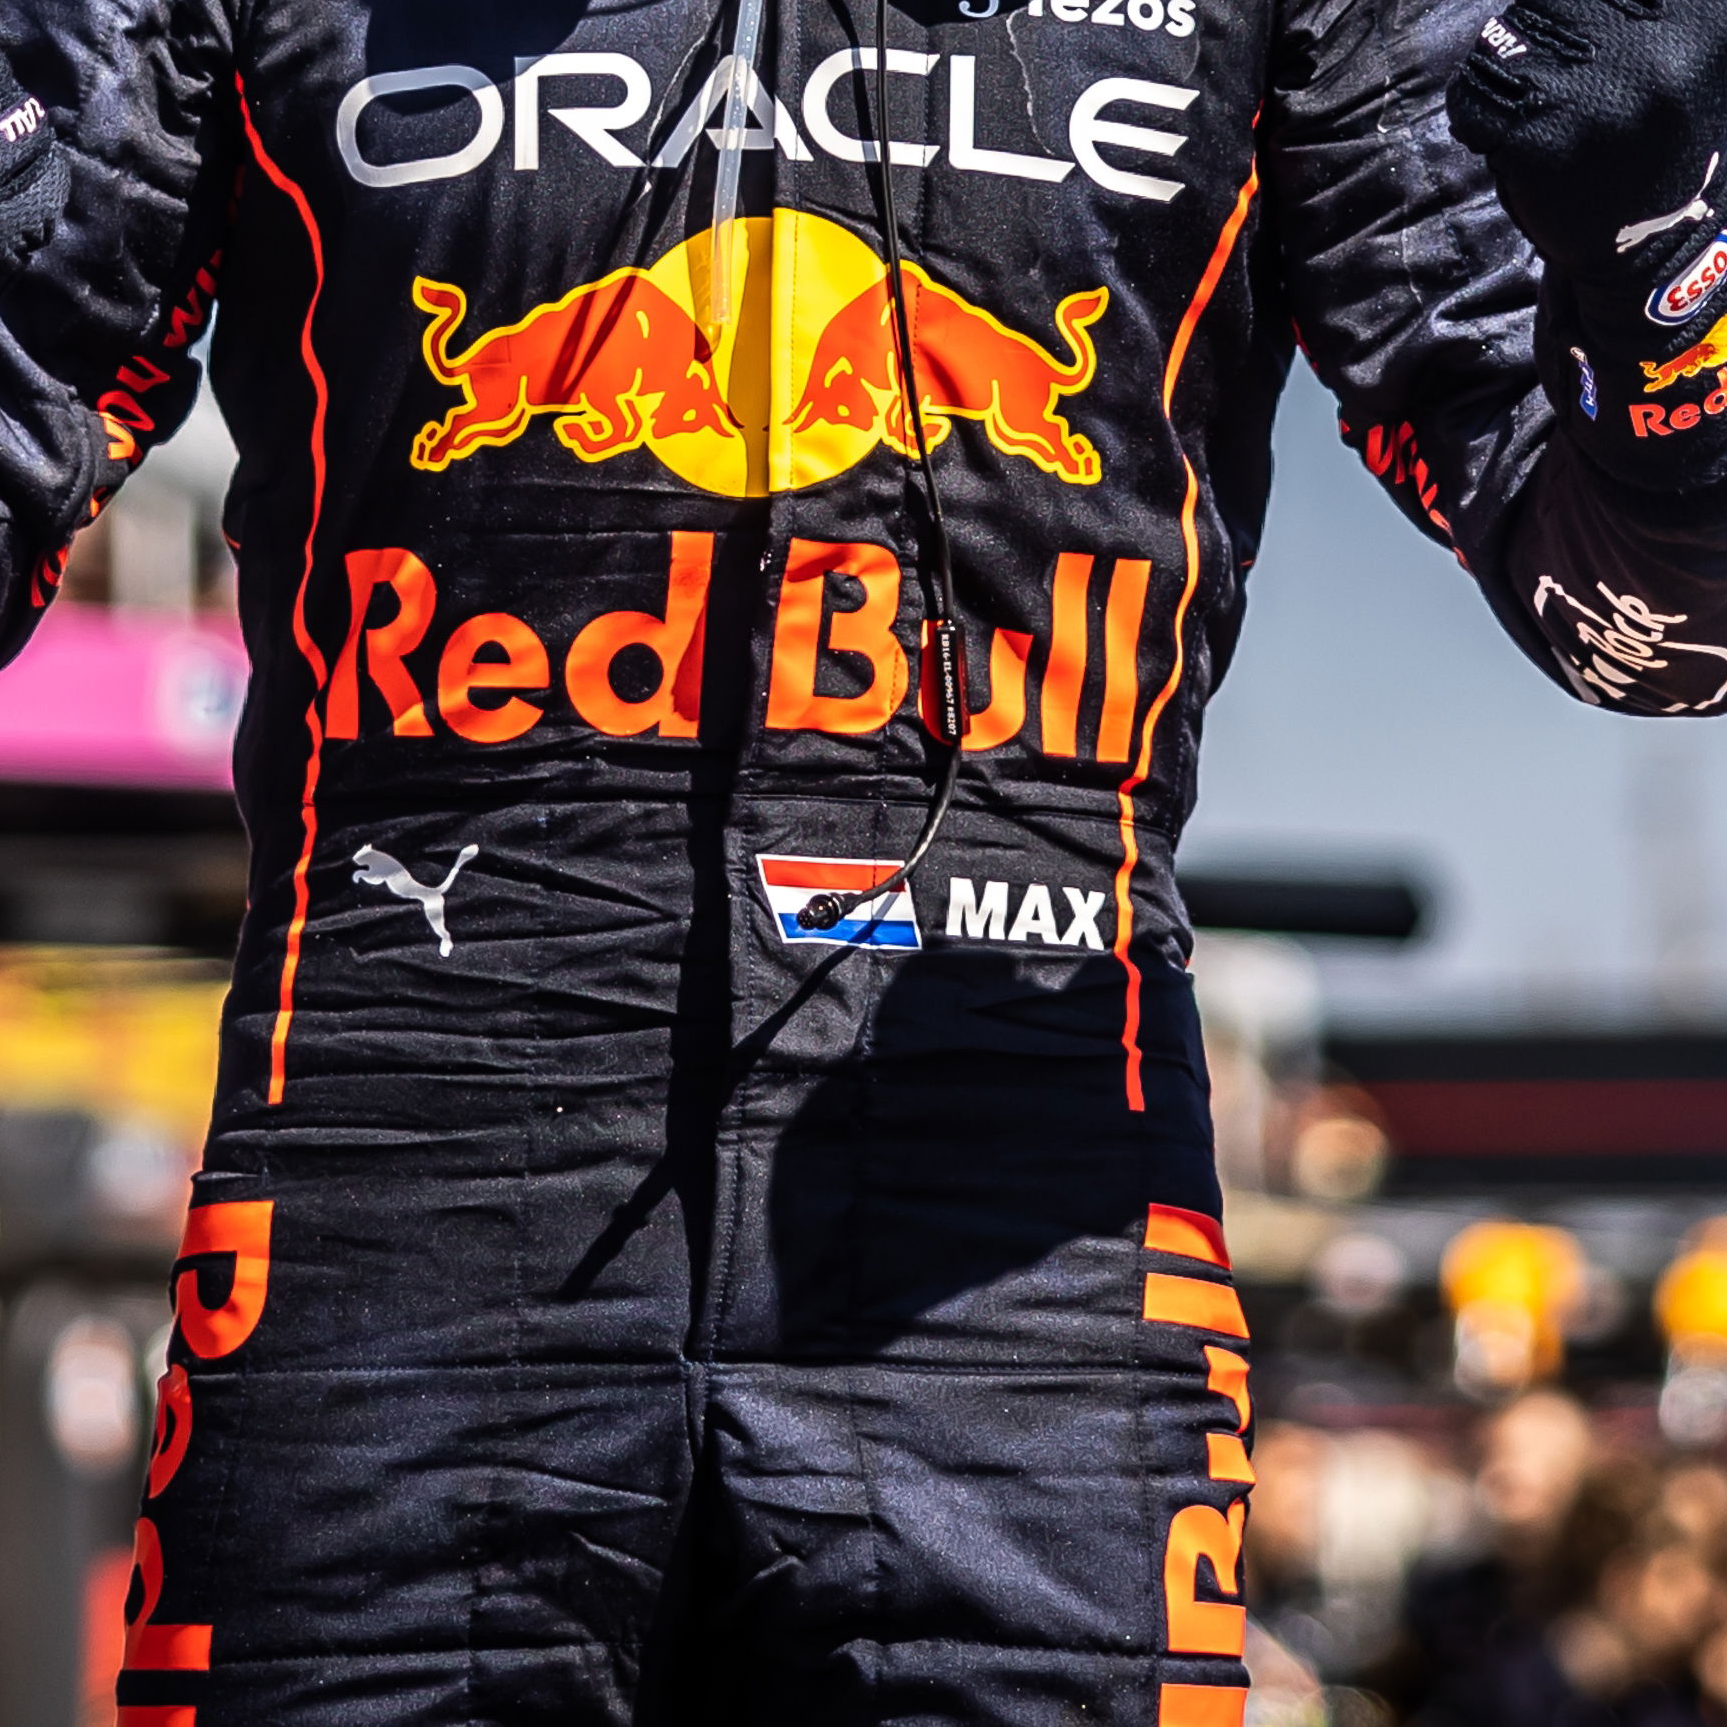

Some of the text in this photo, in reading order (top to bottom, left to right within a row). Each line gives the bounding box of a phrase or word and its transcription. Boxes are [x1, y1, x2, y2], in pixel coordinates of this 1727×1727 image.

[337, 48, 1200, 202] ORACLE
[1667, 251, 1727, 311] Esso
[325, 531, 1150, 762] Red Bull
[946, 877, 1107, 951] MAX
